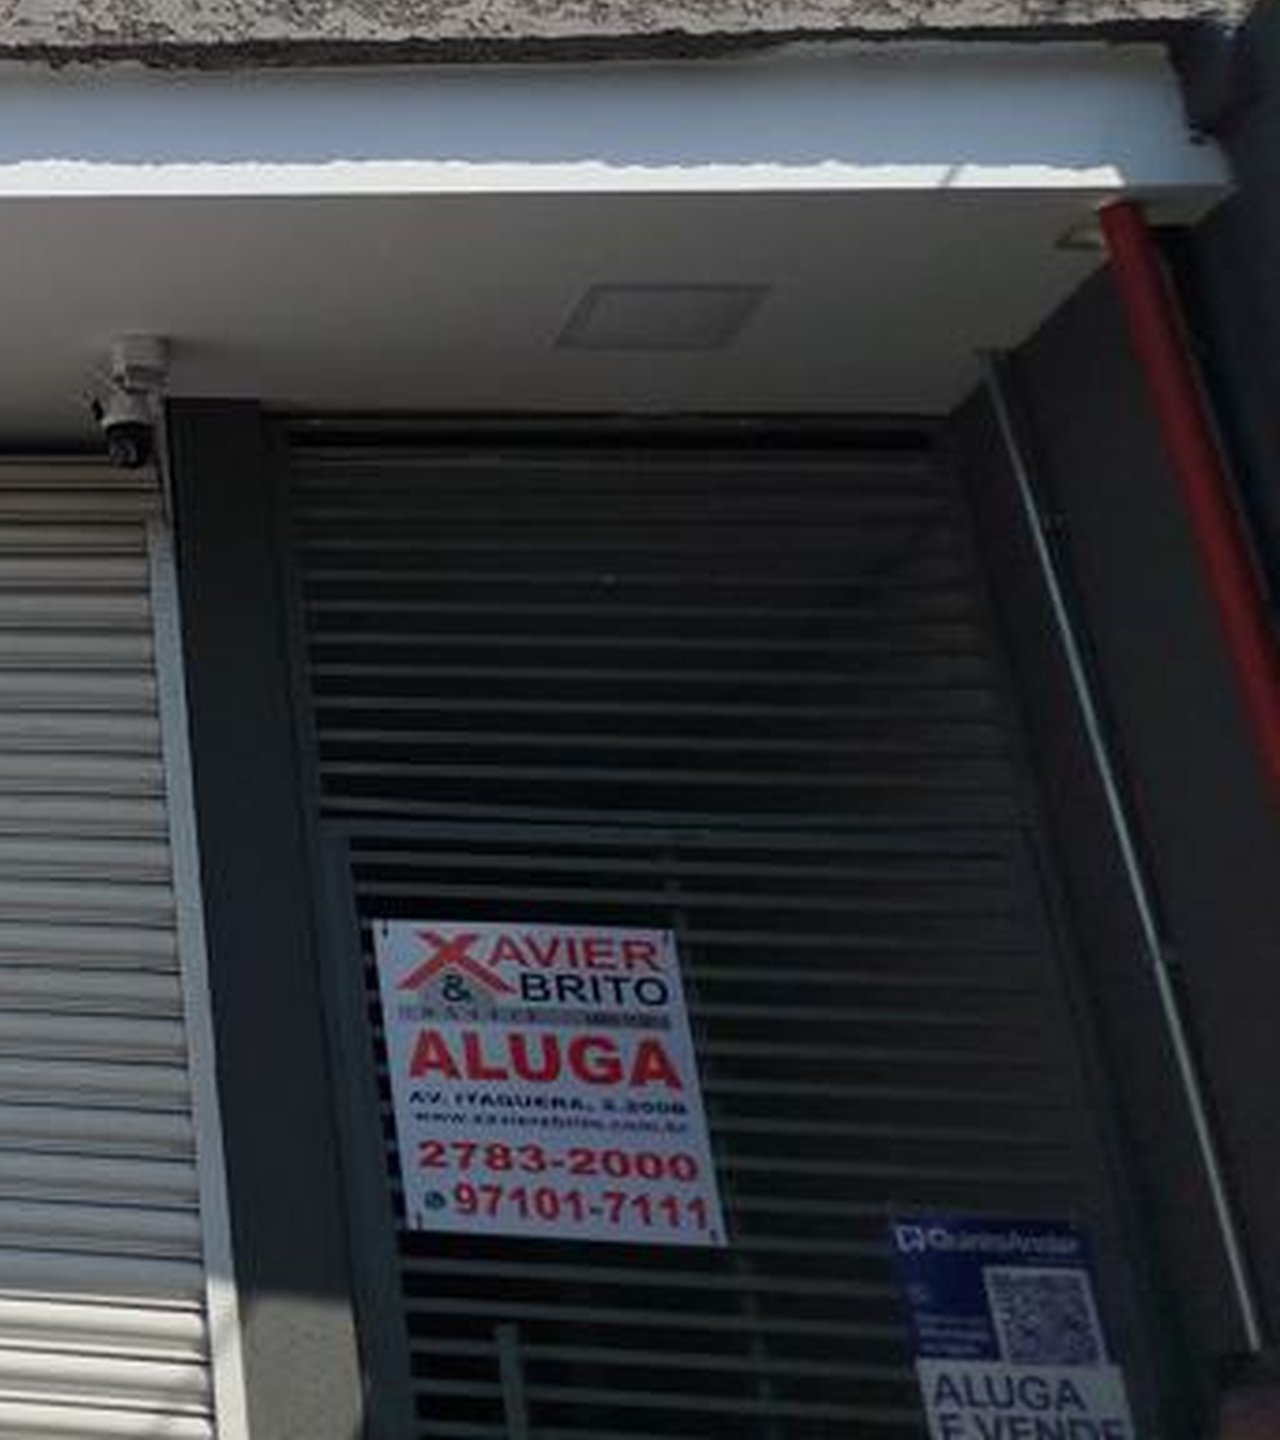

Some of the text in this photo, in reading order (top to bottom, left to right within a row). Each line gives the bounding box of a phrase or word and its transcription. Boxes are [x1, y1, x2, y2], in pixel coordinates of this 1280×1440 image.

[396, 931, 664, 994] XAVIER
[441, 972, 669, 1007] & BRITO
[409, 1028, 683, 1091] ALUGA
[417, 1140, 699, 1183] 2783-2000
[452, 1182, 709, 1231] 97101-7111
[934, 1372, 1088, 1411] ALUGA
